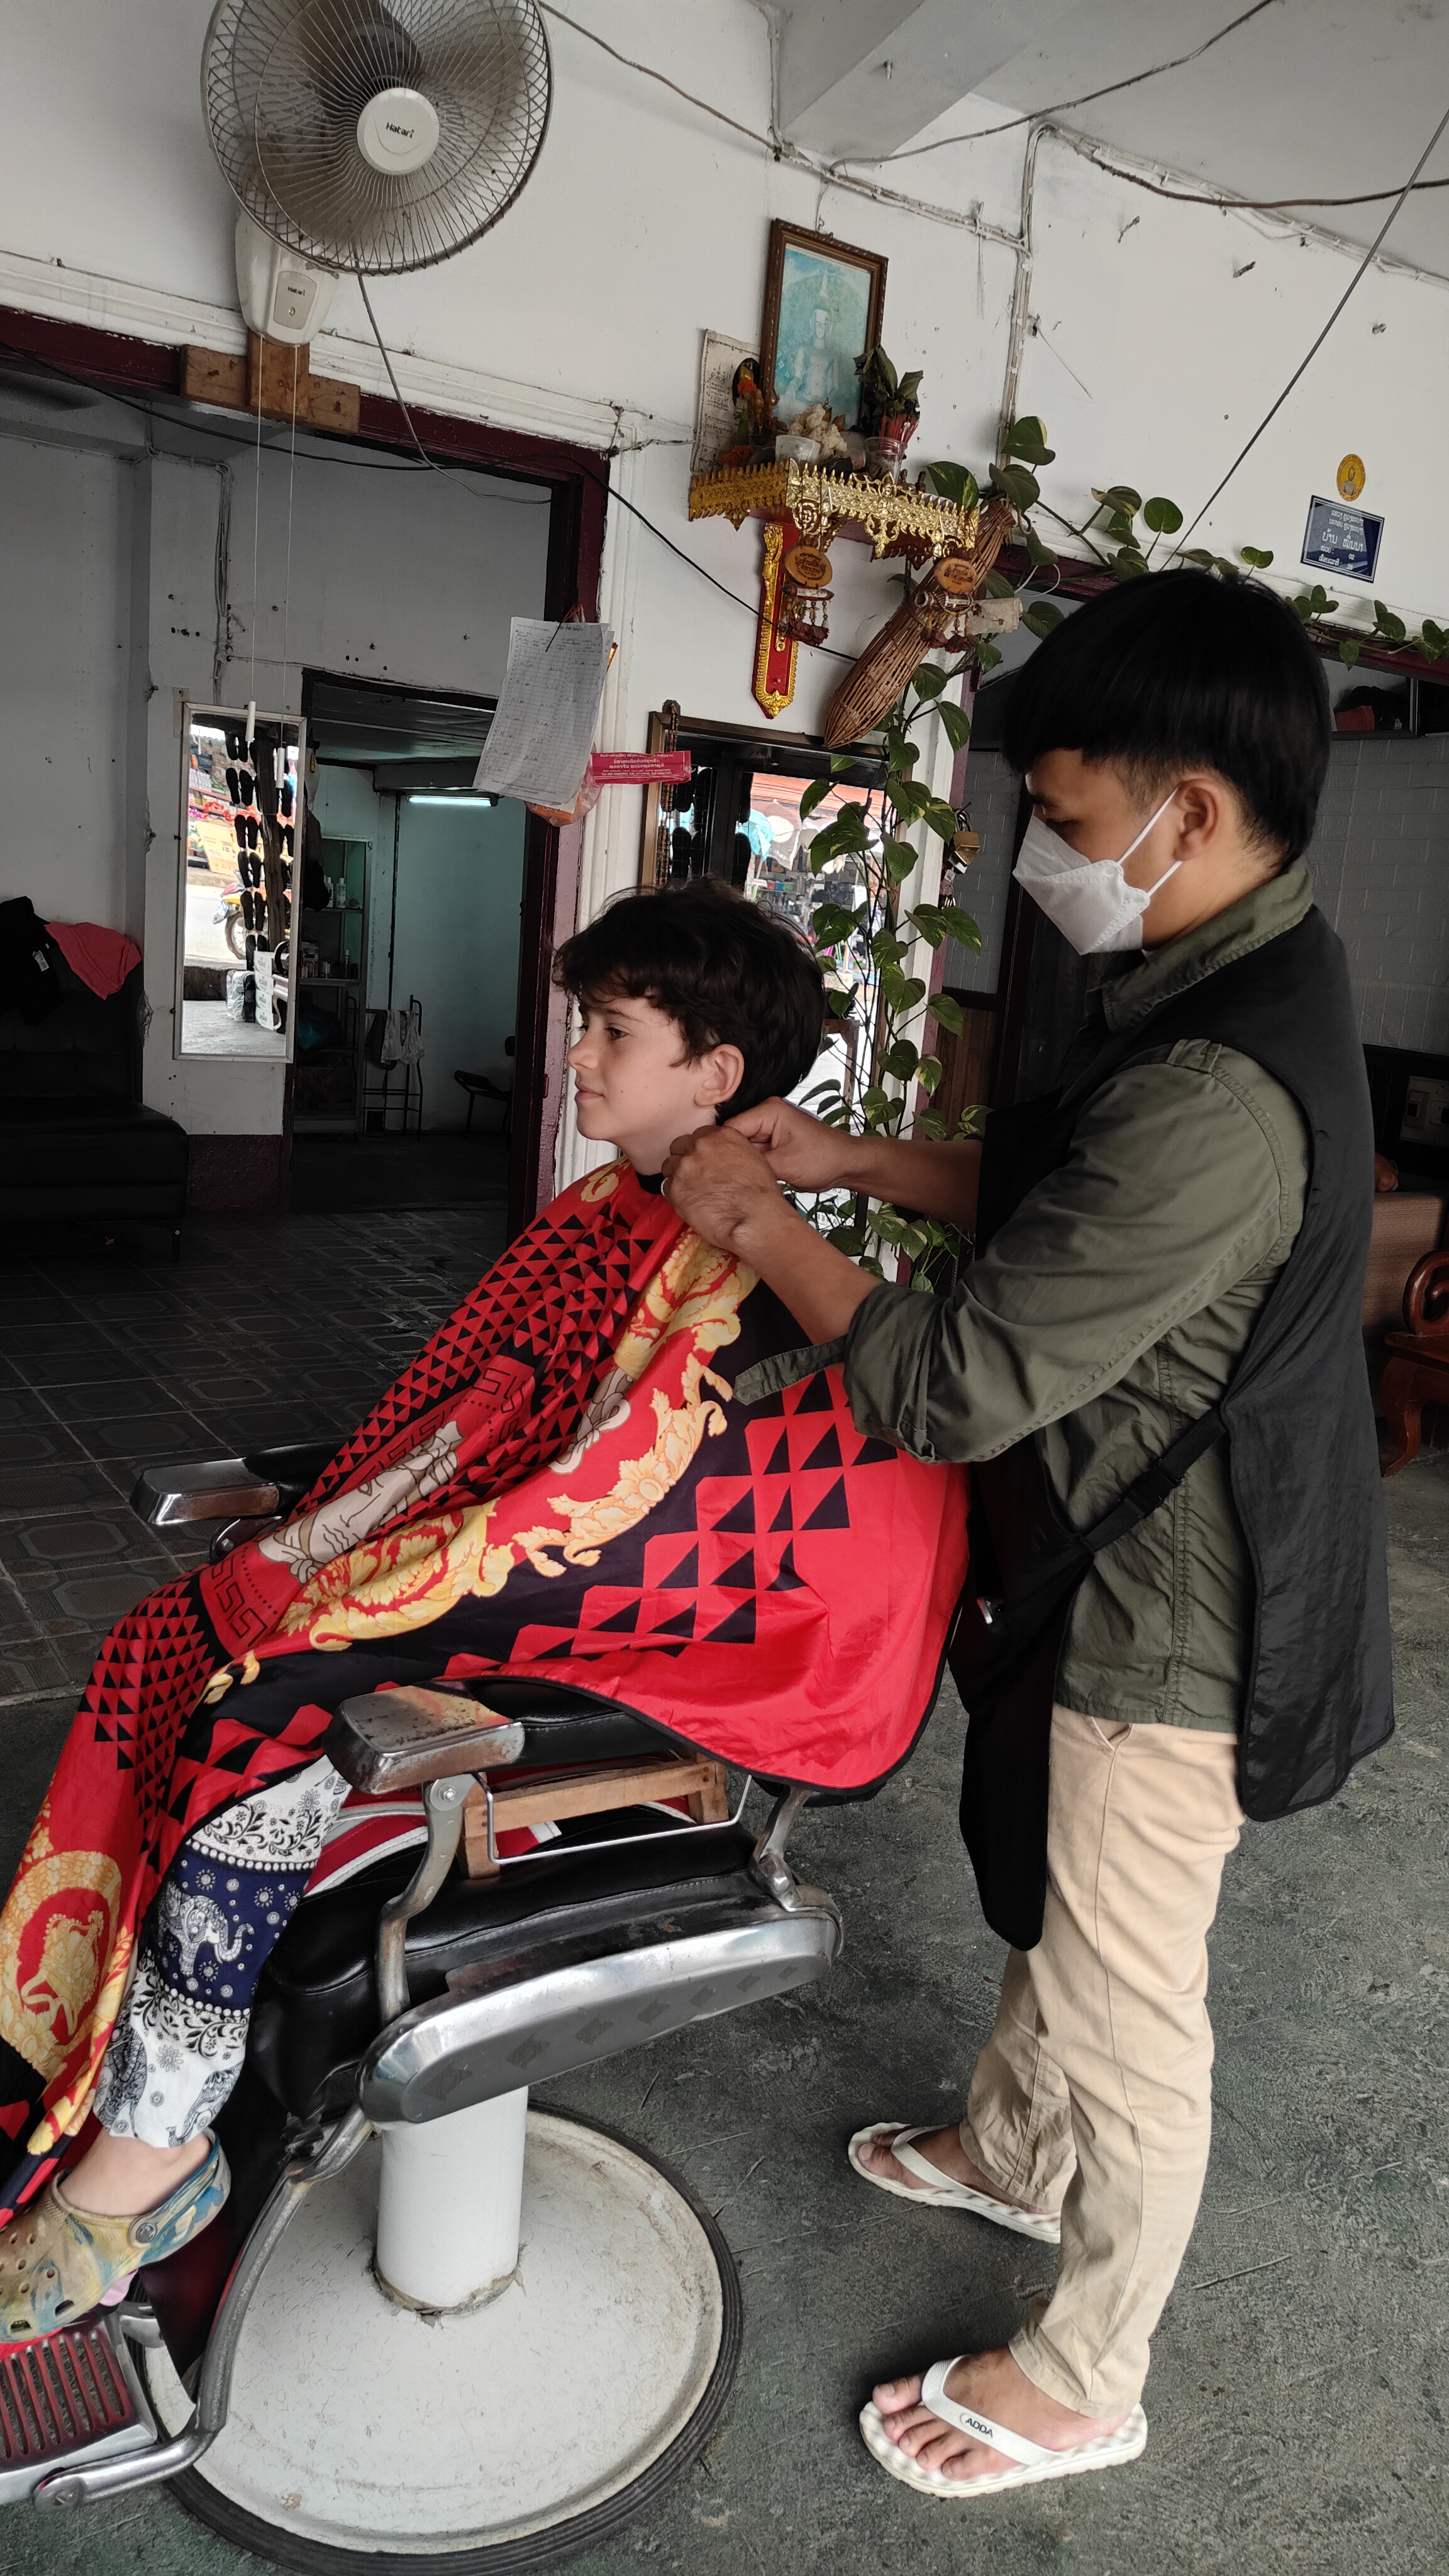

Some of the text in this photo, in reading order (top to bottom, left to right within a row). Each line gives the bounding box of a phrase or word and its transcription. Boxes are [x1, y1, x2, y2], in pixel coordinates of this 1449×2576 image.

[386, 122, 414, 138] Hatari
[287, 286, 306, 296] Hatari
[1322, 528, 1338, 545] ບ້ານ
[965, 2418, 993, 2438] ADDA
